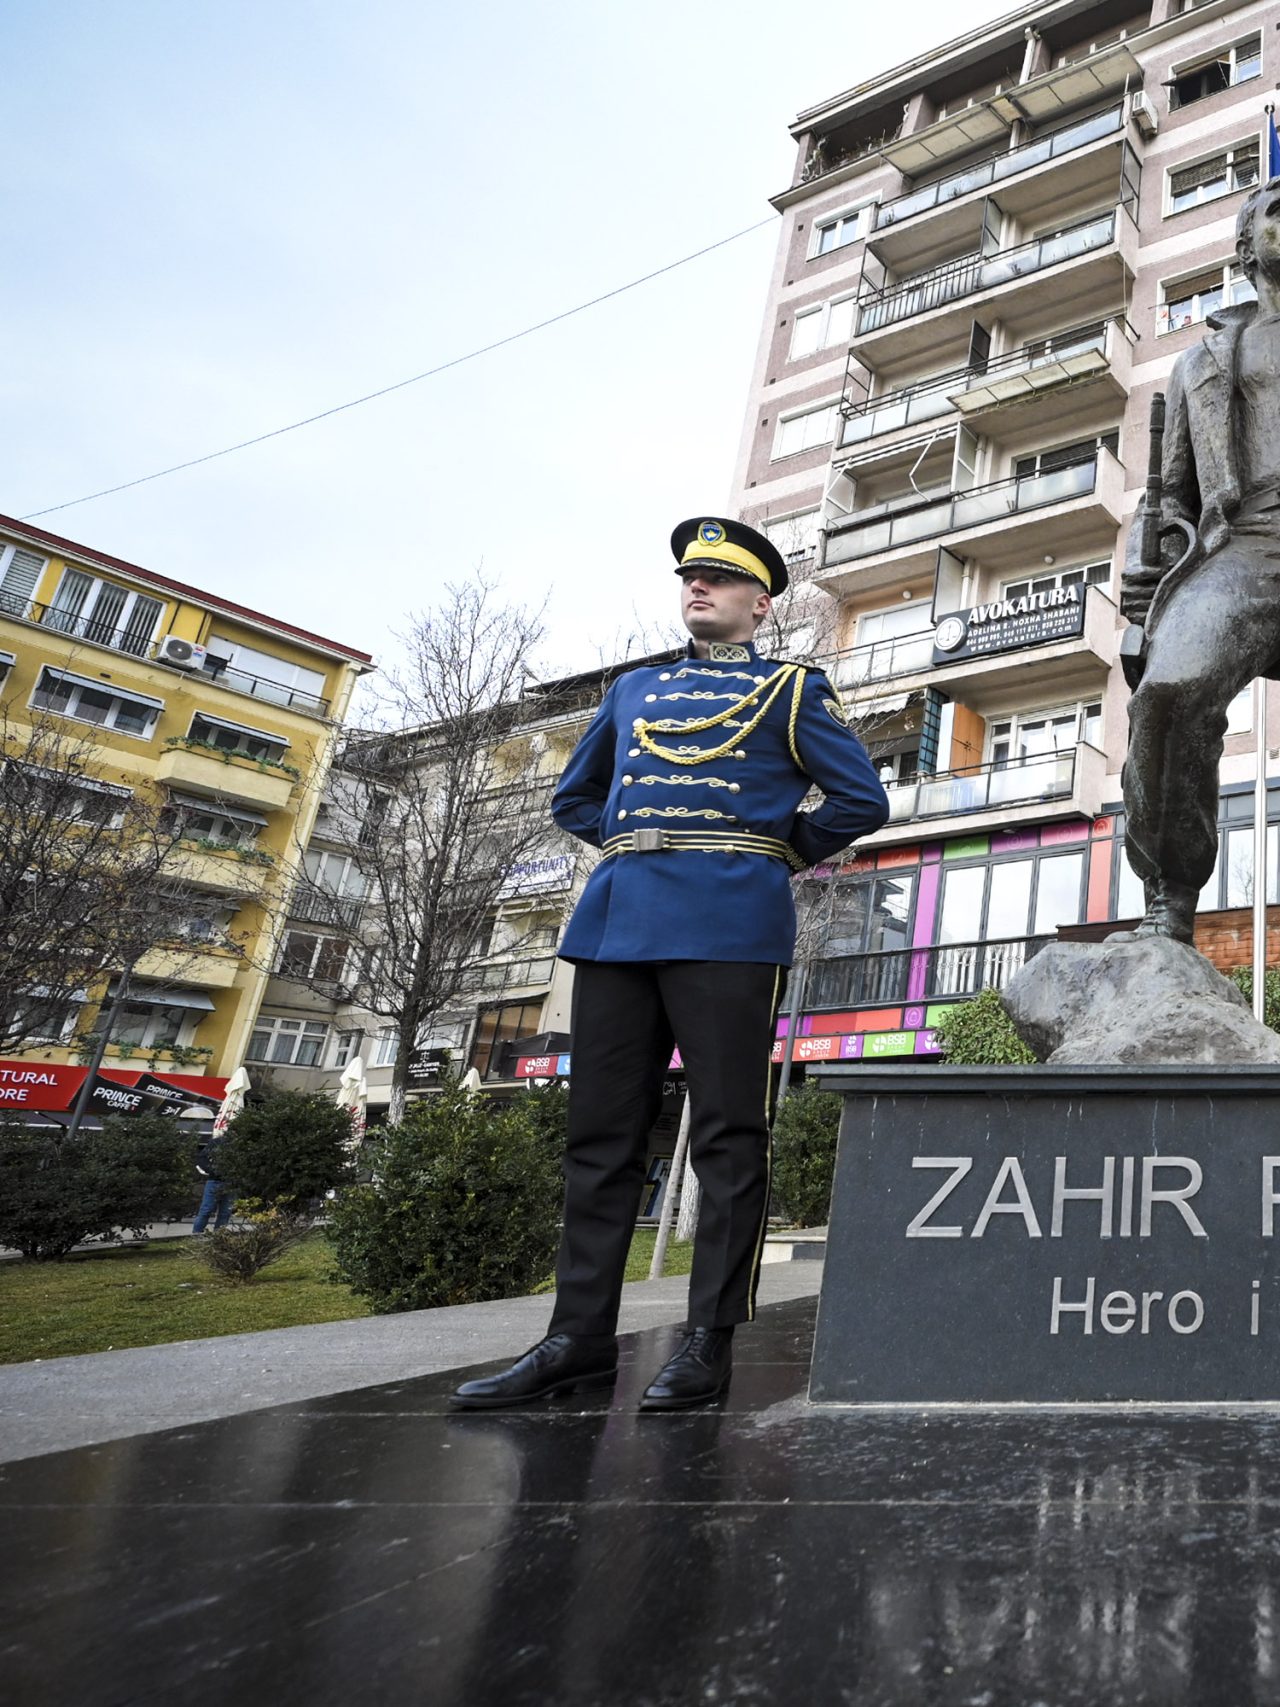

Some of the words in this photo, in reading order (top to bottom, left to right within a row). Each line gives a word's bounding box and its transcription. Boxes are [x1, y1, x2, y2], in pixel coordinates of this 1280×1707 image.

[966, 584, 1079, 625] AVOKATURA
[967, 622, 1001, 638] ADELINA
[1043, 606, 1080, 620] SHABANI
[970, 624, 1072, 652] www.avokatura.com
[813, 1039, 832, 1051] BSB
[887, 1033, 907, 1045] BSB
[536, 1057, 550, 1067] BSB
[93, 1087, 142, 1107] PRINCE
[905, 1155, 1208, 1239] ZAHIR
[1048, 1276, 1204, 1336] Hero
[1250, 1279, 1260, 1336] i
